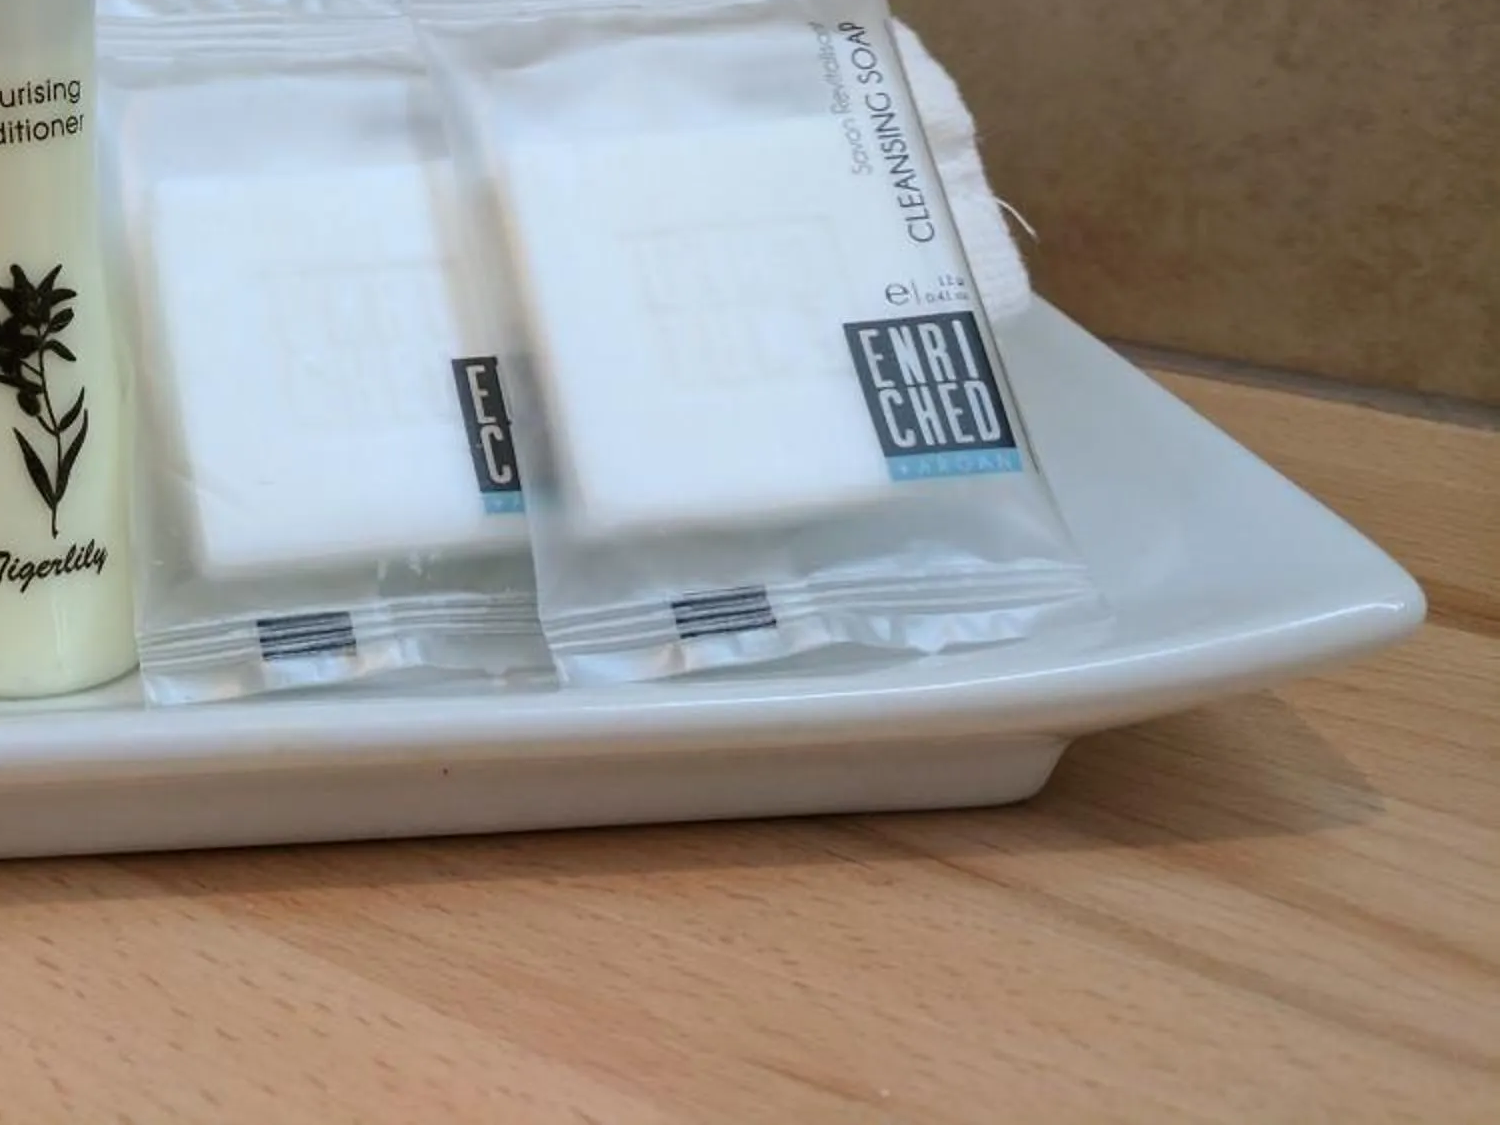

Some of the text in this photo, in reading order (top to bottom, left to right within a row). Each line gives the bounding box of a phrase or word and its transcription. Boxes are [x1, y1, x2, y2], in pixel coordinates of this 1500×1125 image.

[837, 21, 936, 244] CLEANSING SOAP
[858, 319, 980, 389] ENRI
[878, 379, 1001, 448] CHED
